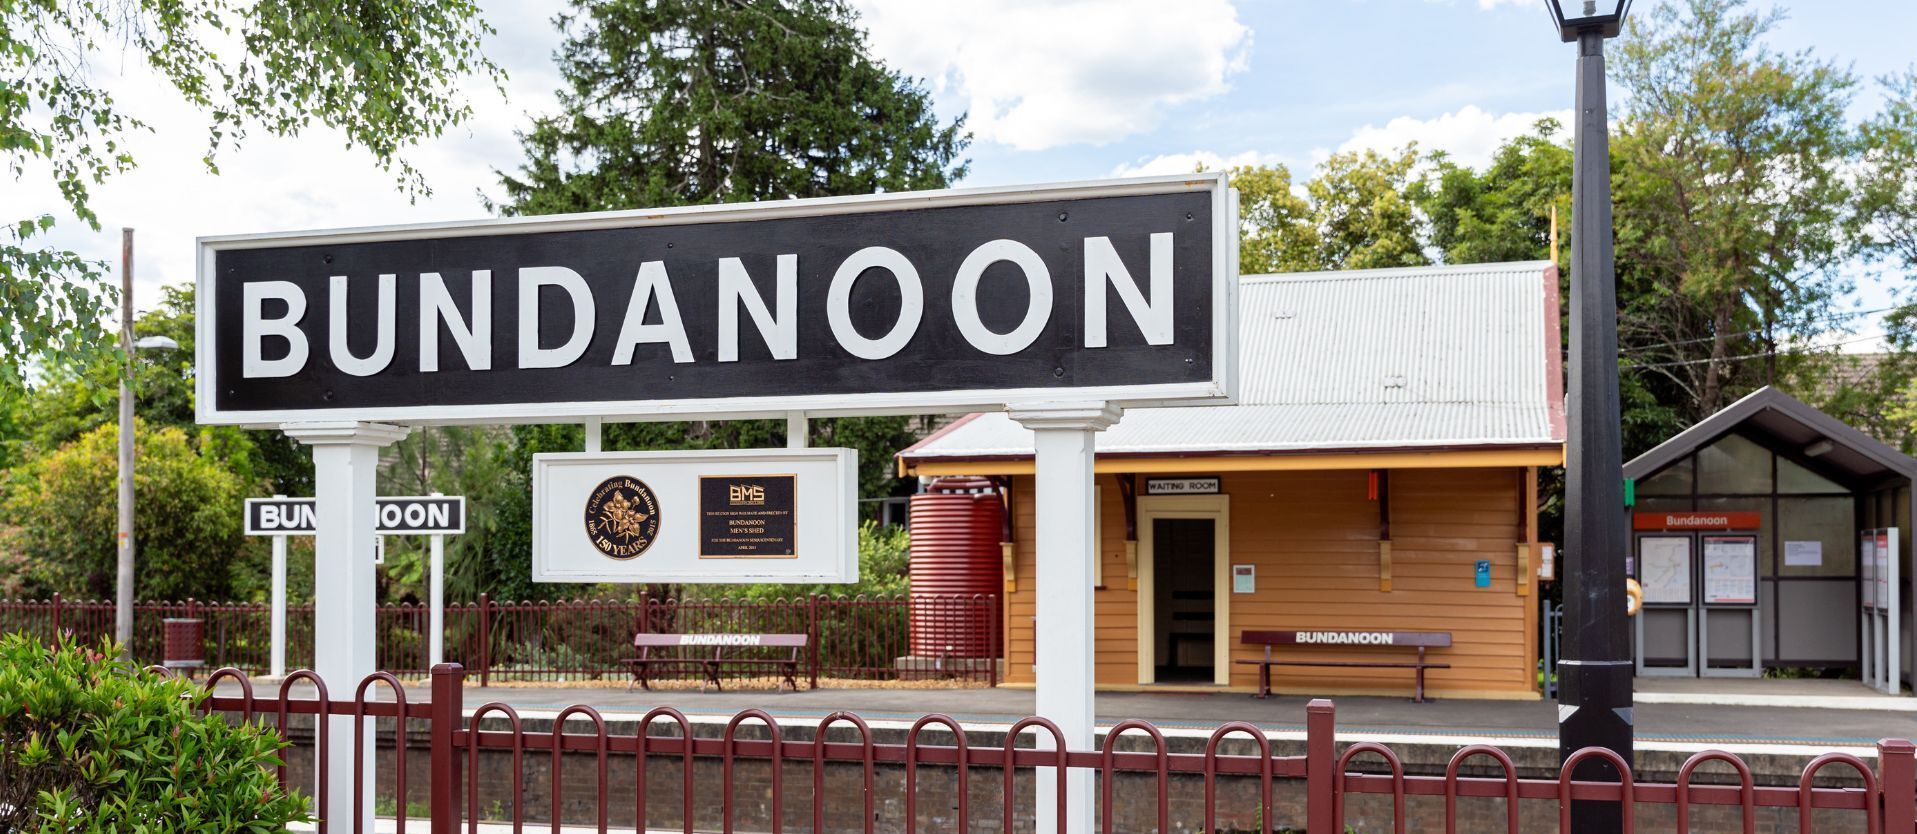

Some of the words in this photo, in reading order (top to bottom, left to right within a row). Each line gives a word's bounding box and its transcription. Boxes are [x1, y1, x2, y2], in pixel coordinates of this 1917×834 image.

[242, 231, 1175, 379] BUNDANOON
[729, 484, 765, 501] BMS
[1149, 482, 1184, 490] WAITING
[1189, 481, 1216, 490] ROOM
[589, 481, 623, 514] Celebrating
[625, 480, 656, 515] Bundanoon
[260, 503, 449, 529] BUNOON
[1666, 516, 1728, 526] Bundanoon
[646, 519, 657, 536] 2015
[596, 535, 612, 552] 150
[612, 536, 648, 556] YEARS
[680, 634, 761, 646] BUNDANOON
[1296, 631, 1393, 645] BUNDANOON
